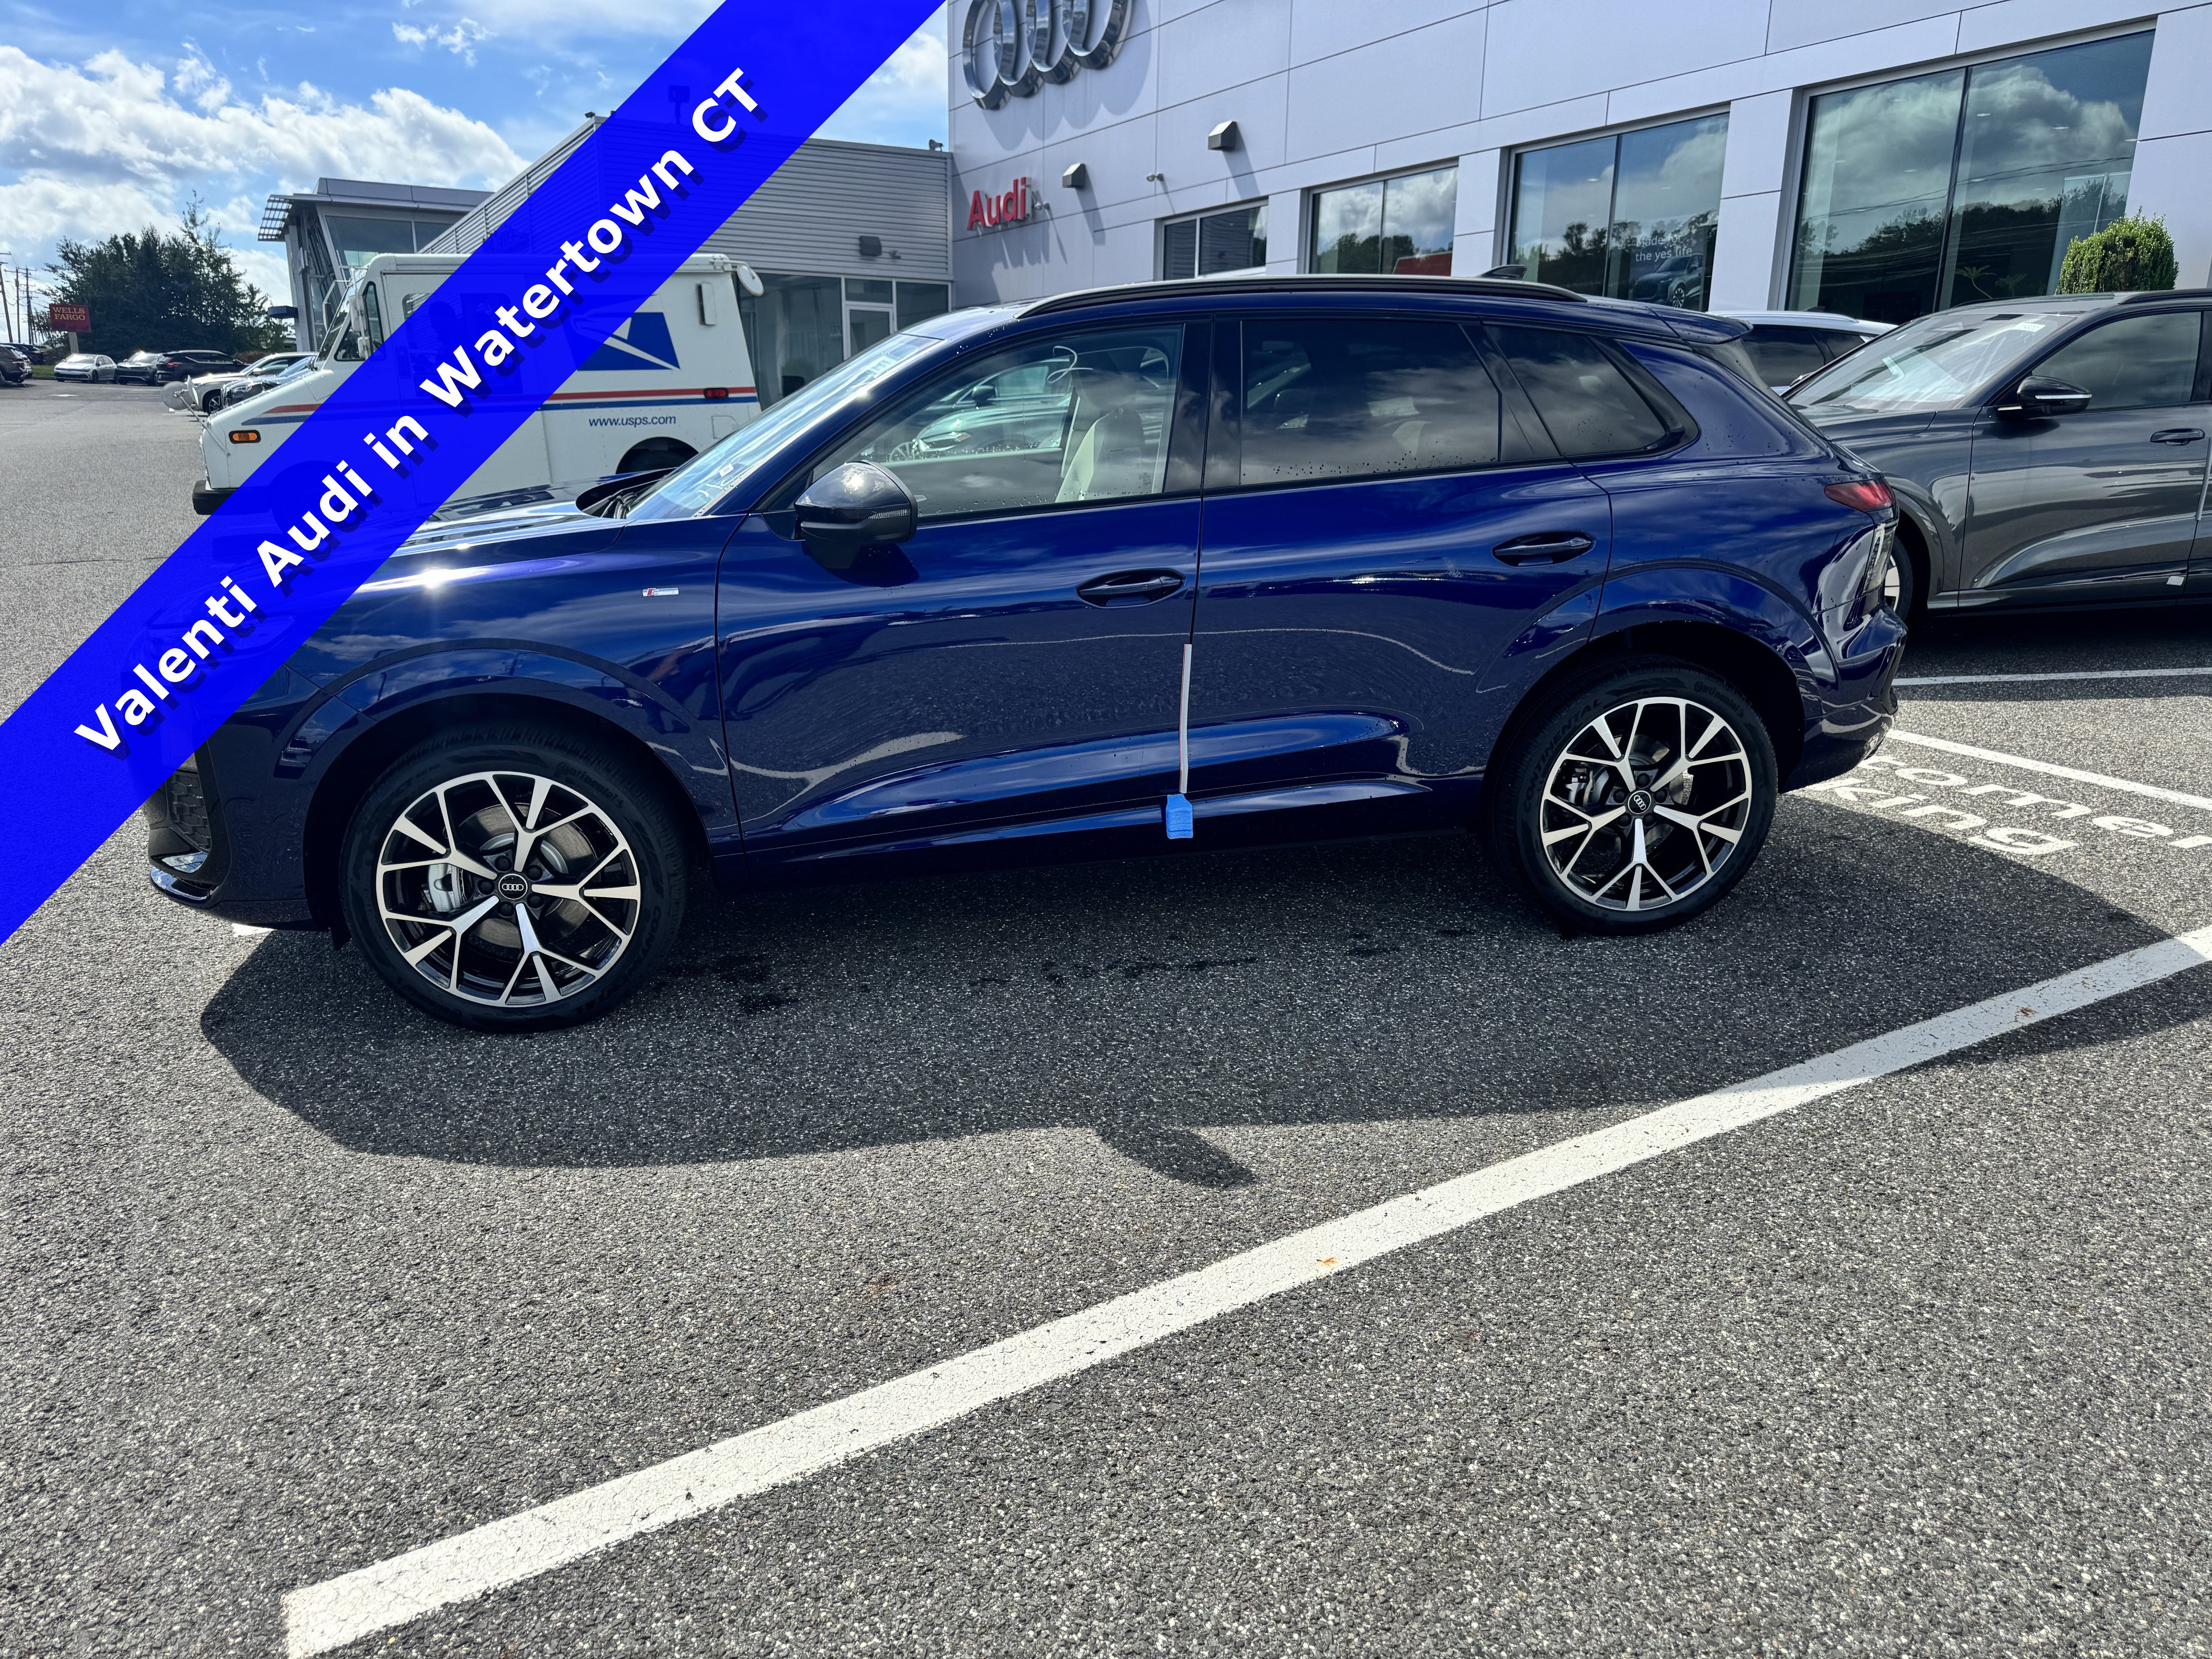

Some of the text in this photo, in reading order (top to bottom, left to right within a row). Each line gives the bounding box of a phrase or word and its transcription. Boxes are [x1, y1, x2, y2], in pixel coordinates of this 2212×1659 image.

[967, 177, 1026, 230] Audi
[1635, 245, 1693, 262] the yes life
[589, 416, 677, 428] www.usps.com
[1524, 699, 1602, 814] CONTINENTAL
[1803, 778, 2080, 855] king
